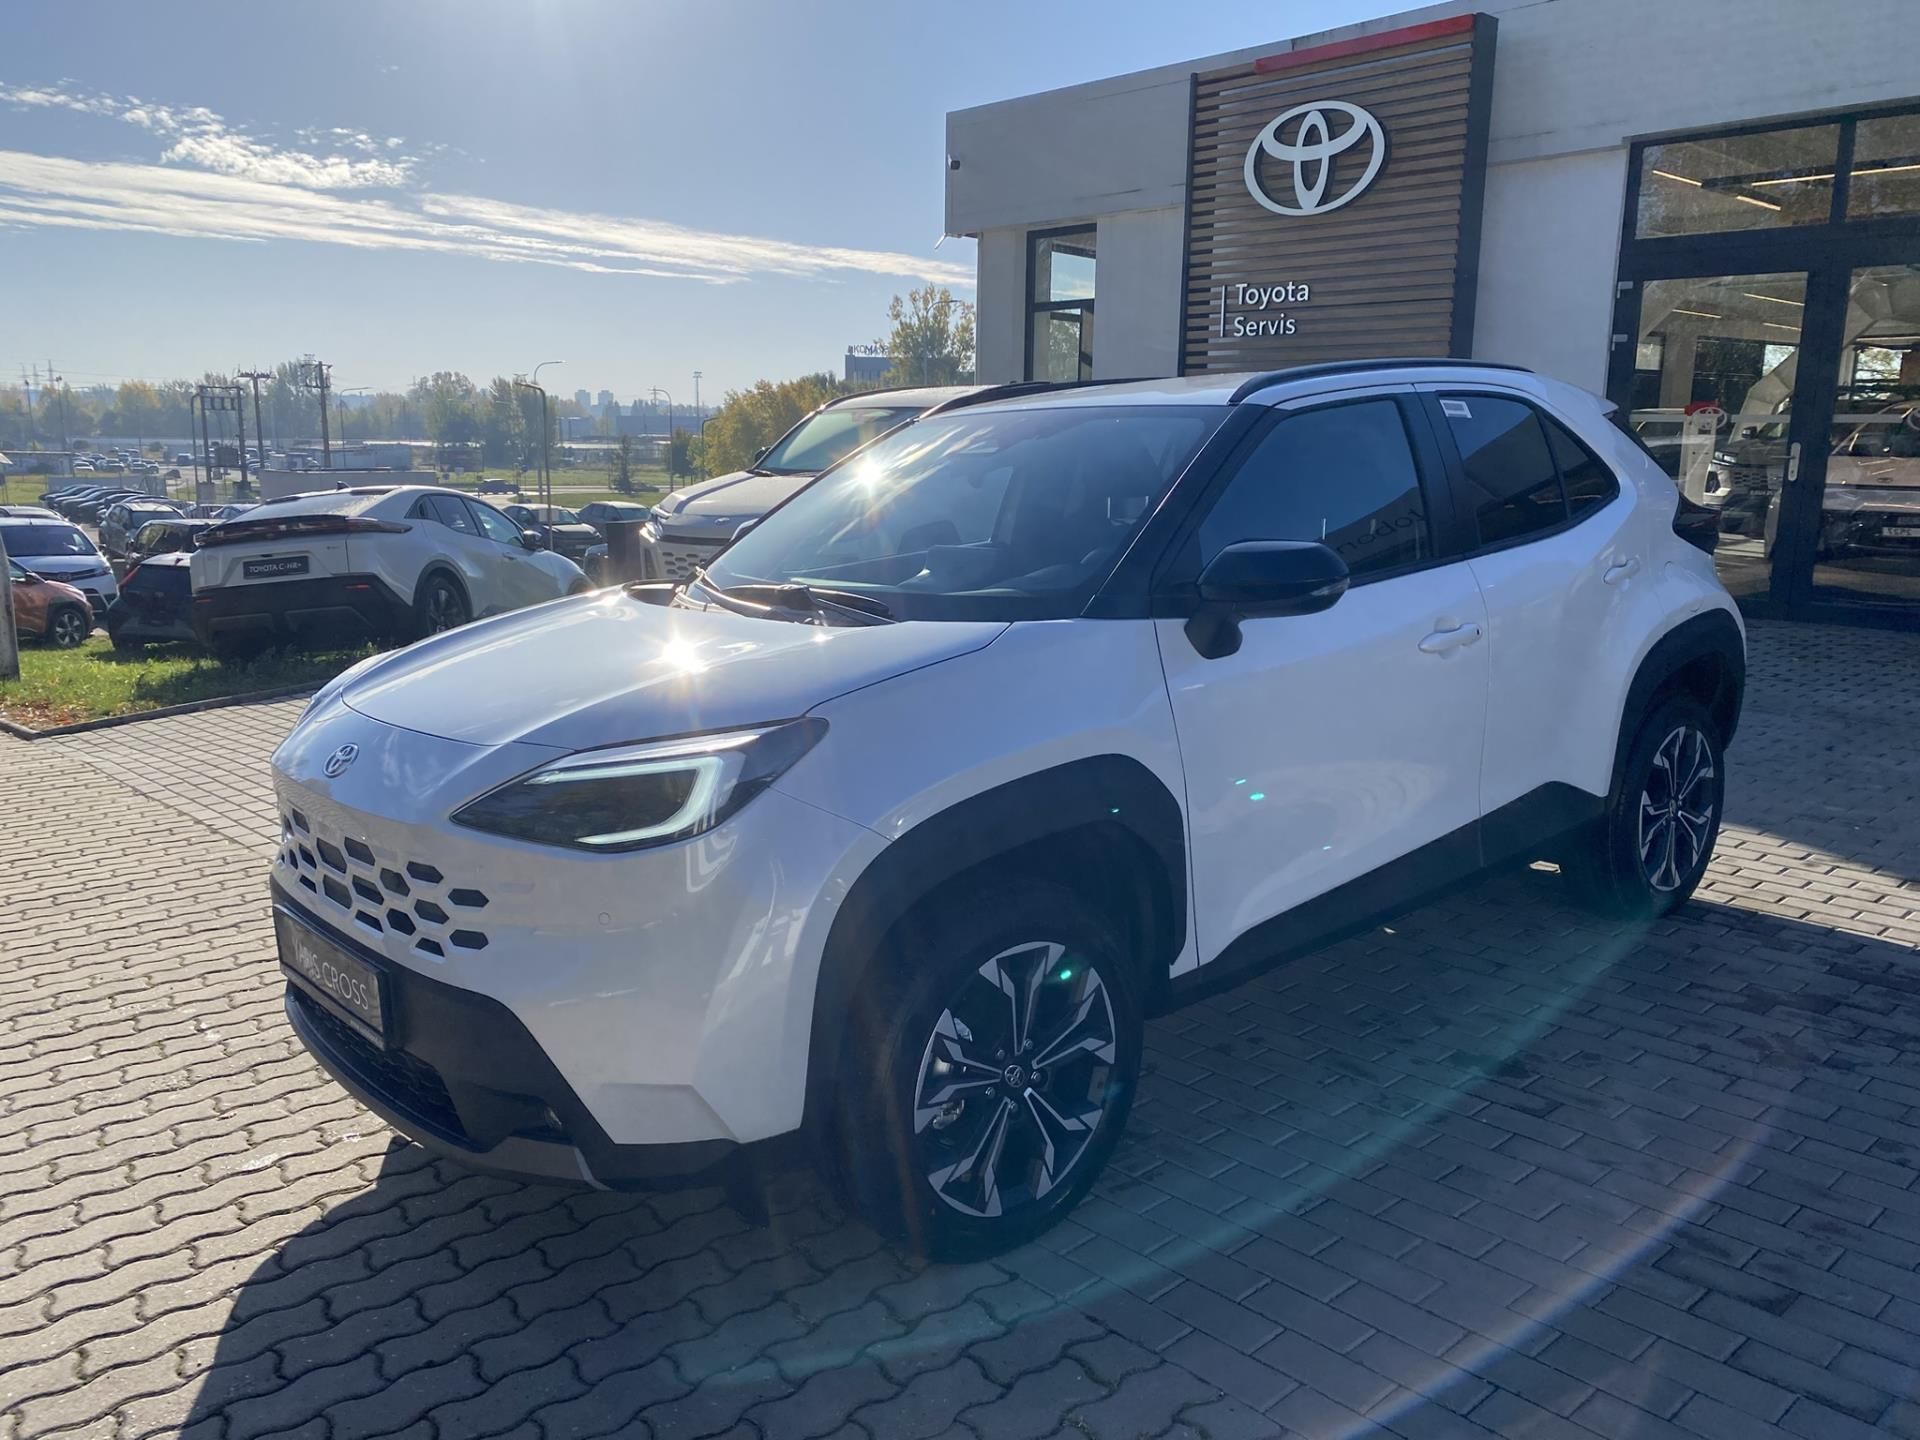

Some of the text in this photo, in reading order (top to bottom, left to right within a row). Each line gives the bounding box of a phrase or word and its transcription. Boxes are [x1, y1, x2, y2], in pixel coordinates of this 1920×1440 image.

[1235, 281, 1309, 310] Toyota
[1233, 313, 1296, 337] Servis
[249, 563, 278, 573] TOYOTA
[322, 961, 369, 1010] CROSS
